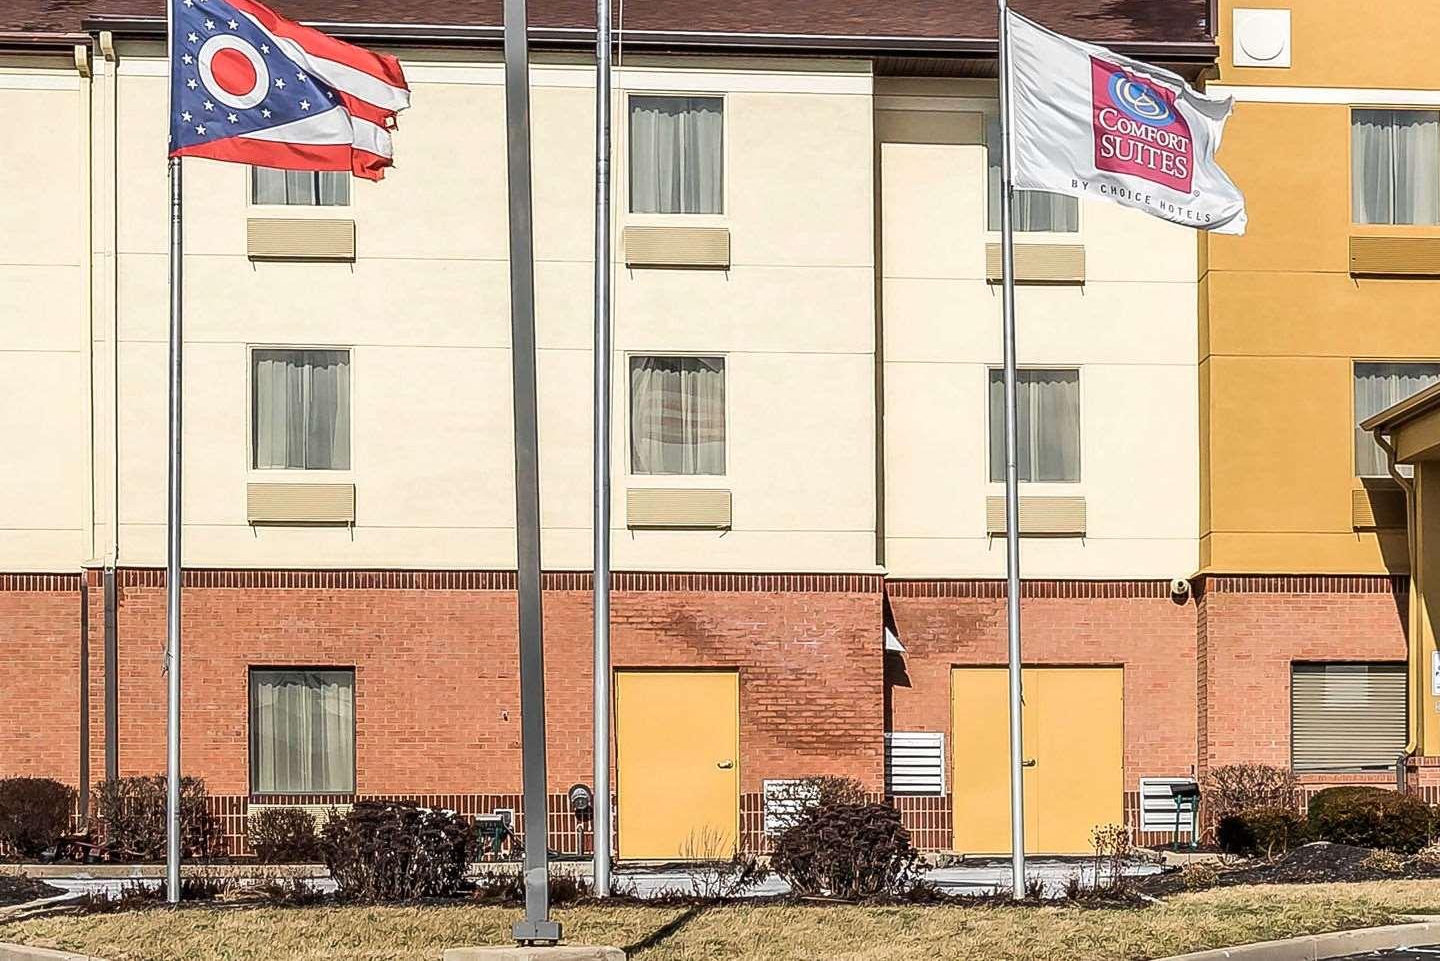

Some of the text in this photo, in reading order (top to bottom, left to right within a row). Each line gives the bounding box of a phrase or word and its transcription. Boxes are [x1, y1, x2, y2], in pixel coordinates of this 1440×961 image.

[1101, 134, 1188, 179] SUITES
[1071, 179, 1212, 223] BY CHOICE HOTELS
